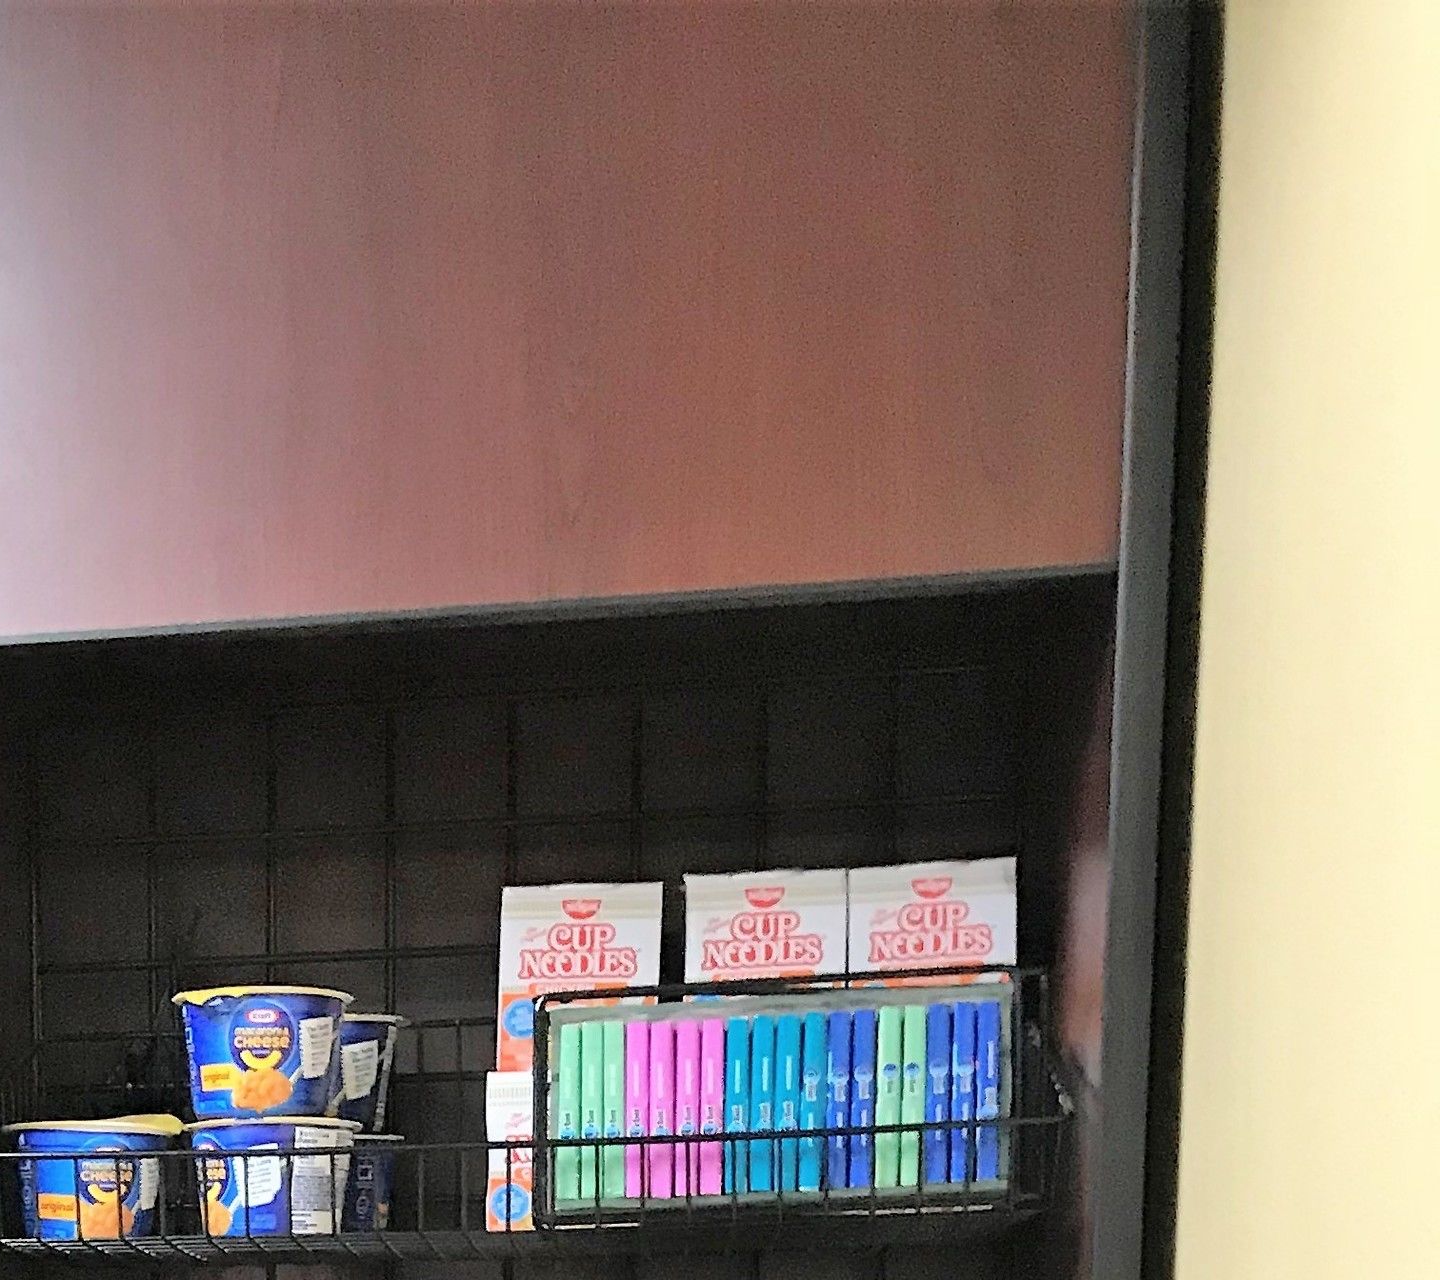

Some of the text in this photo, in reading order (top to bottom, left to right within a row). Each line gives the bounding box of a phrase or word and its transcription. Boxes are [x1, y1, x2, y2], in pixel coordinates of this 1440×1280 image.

[731, 911, 800, 941] CUP
[898, 901, 969, 933] CUP
[547, 923, 616, 950] CUP
[701, 934, 824, 970] NOODLES
[869, 924, 993, 962] NOODLES
[518, 948, 638, 979] NOODLES
